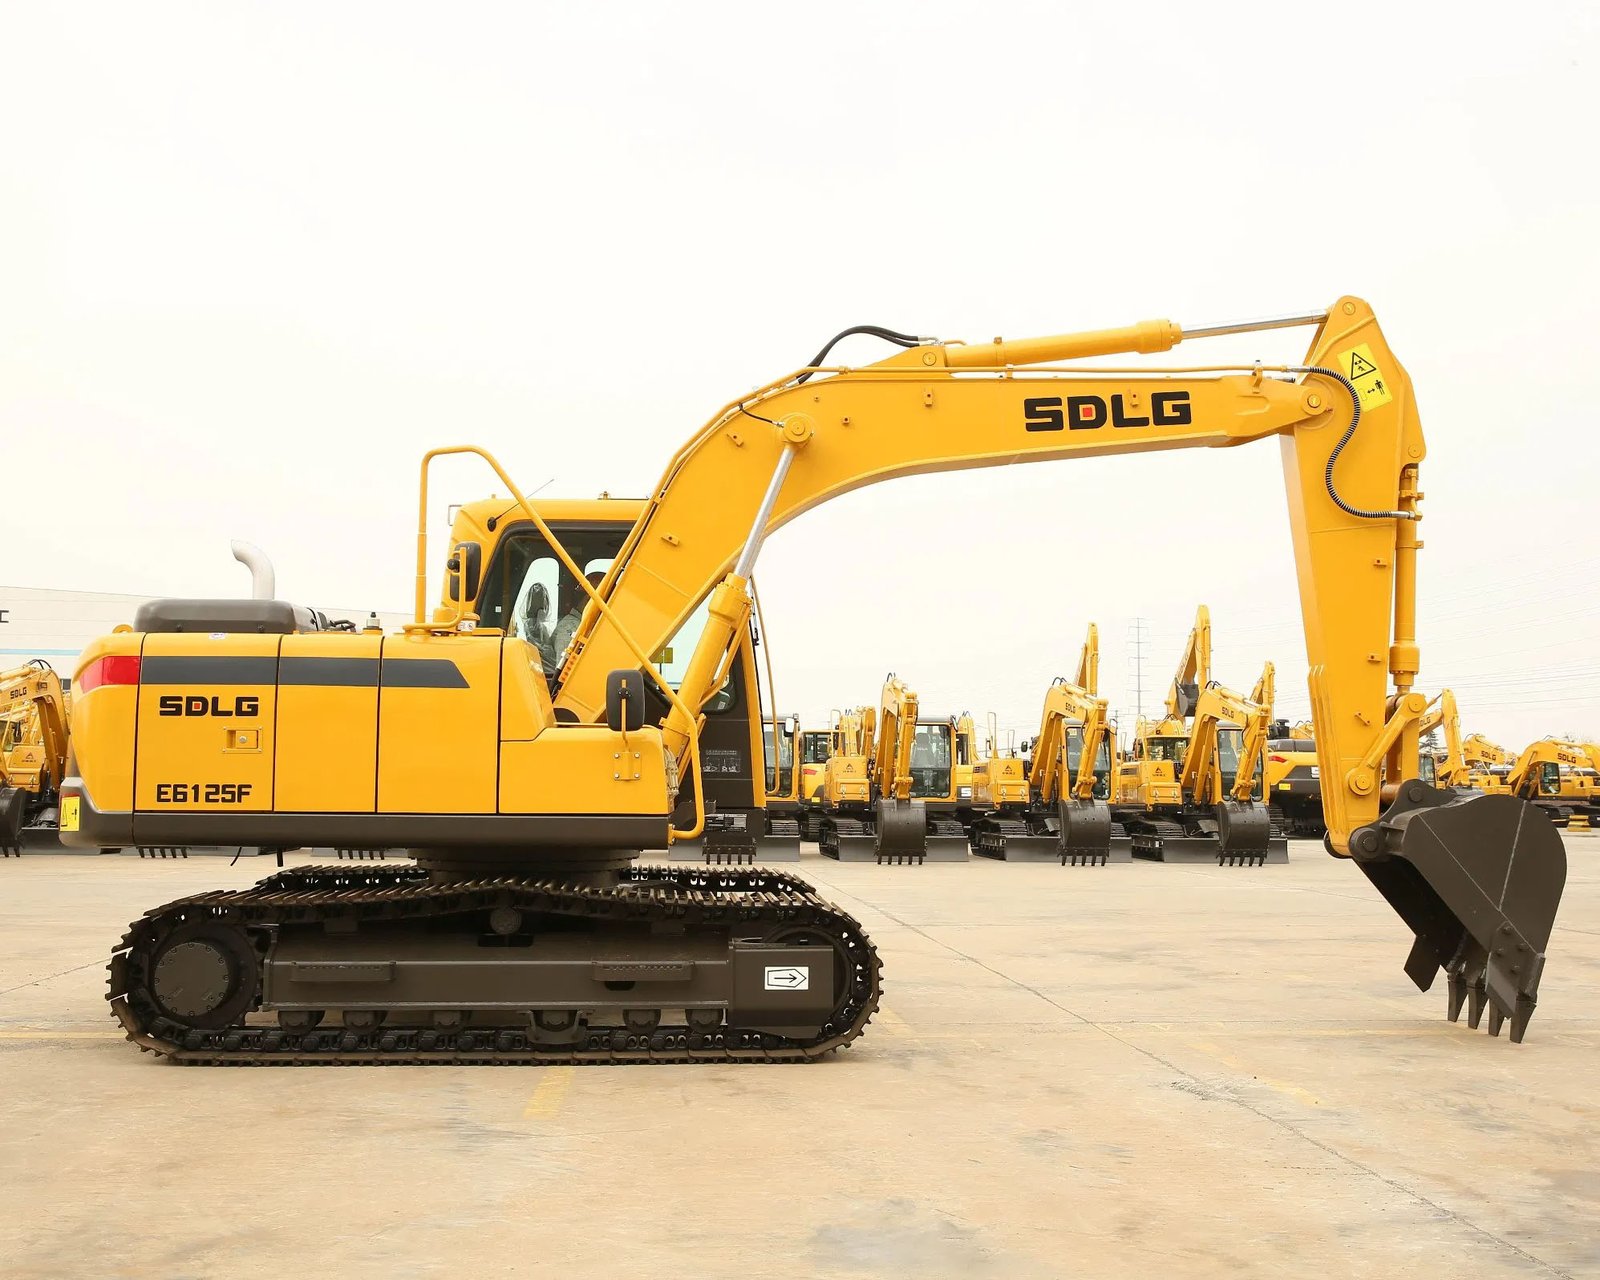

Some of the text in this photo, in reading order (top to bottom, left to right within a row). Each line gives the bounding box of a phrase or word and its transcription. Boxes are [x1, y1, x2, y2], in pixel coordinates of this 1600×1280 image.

[1024, 391, 1191, 432] SDLG
[10, 686, 27, 699] SDLG
[159, 696, 259, 716] SDLG
[1481, 750, 1496, 760] SDLG
[1557, 752, 1576, 764] SDLG
[157, 784, 252, 803] E6125F
